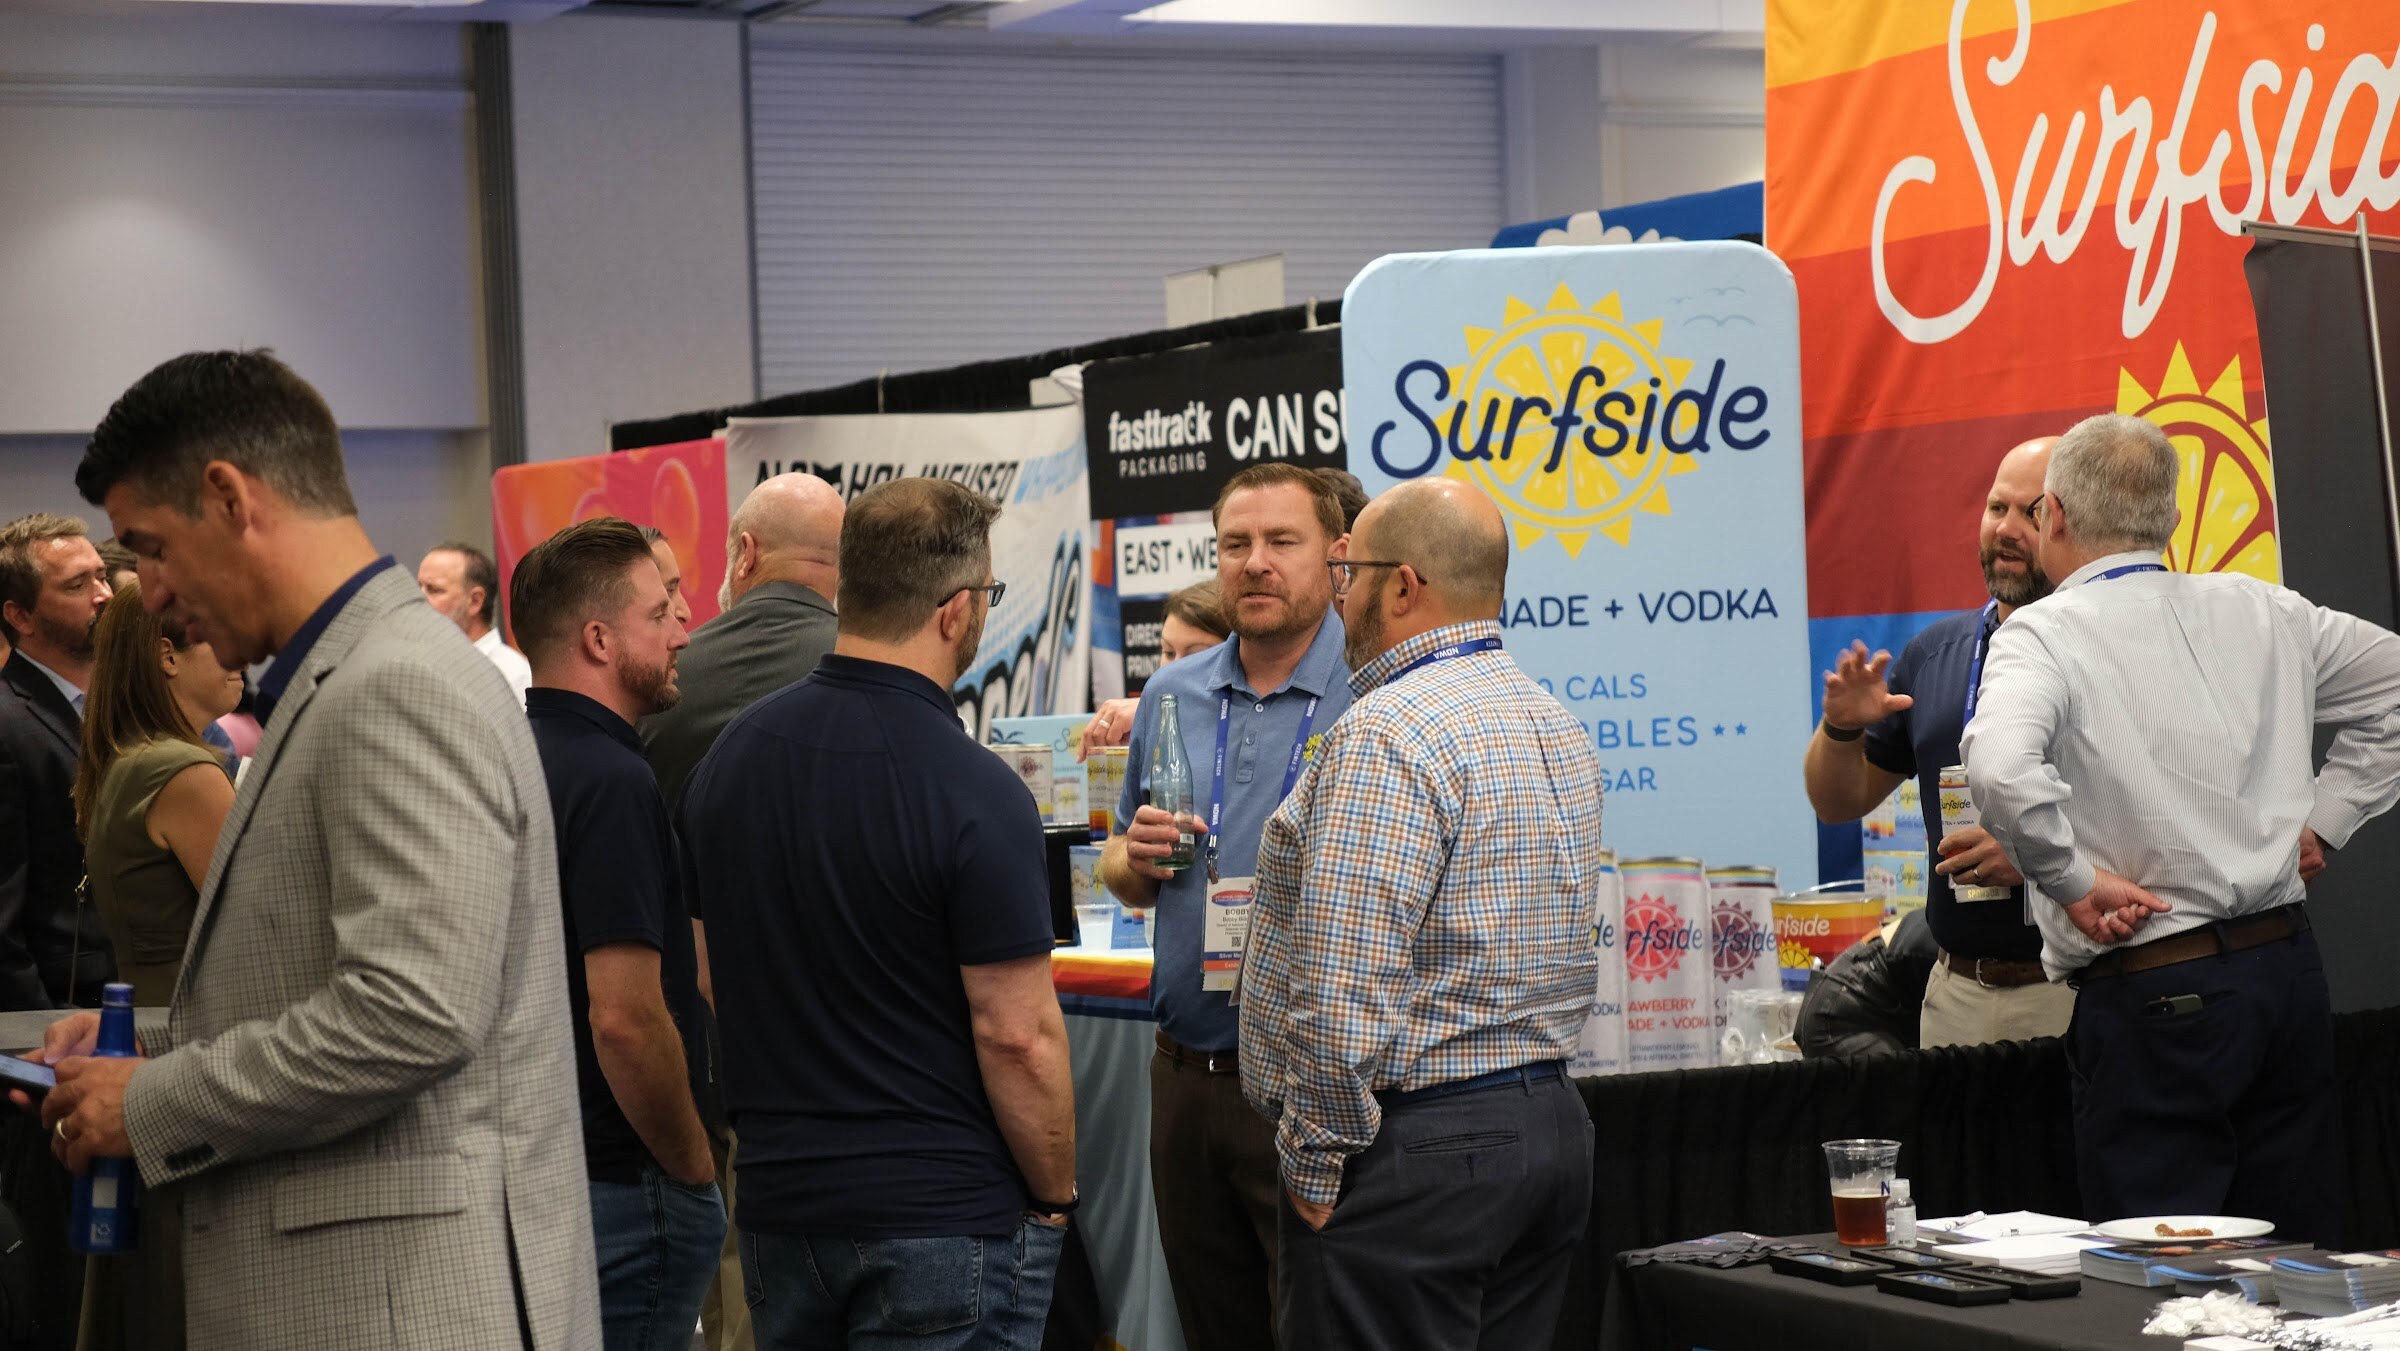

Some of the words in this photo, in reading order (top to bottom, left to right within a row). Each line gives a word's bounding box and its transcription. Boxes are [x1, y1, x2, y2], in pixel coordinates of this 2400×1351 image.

[1108, 400, 1213, 453] fasttrack
[1226, 392, 1306, 461] CAN
[1371, 358, 1771, 479] Surfside
[1119, 450, 1207, 478] PACKAGING
[1124, 540, 1171, 575] EAST
[1604, 598, 1624, 619] +
[1638, 586, 1779, 624] VODKA
[1565, 673, 1647, 701] CALS
[1625, 919, 1703, 957] rfside
[1672, 1015, 1711, 1030] VODKA
